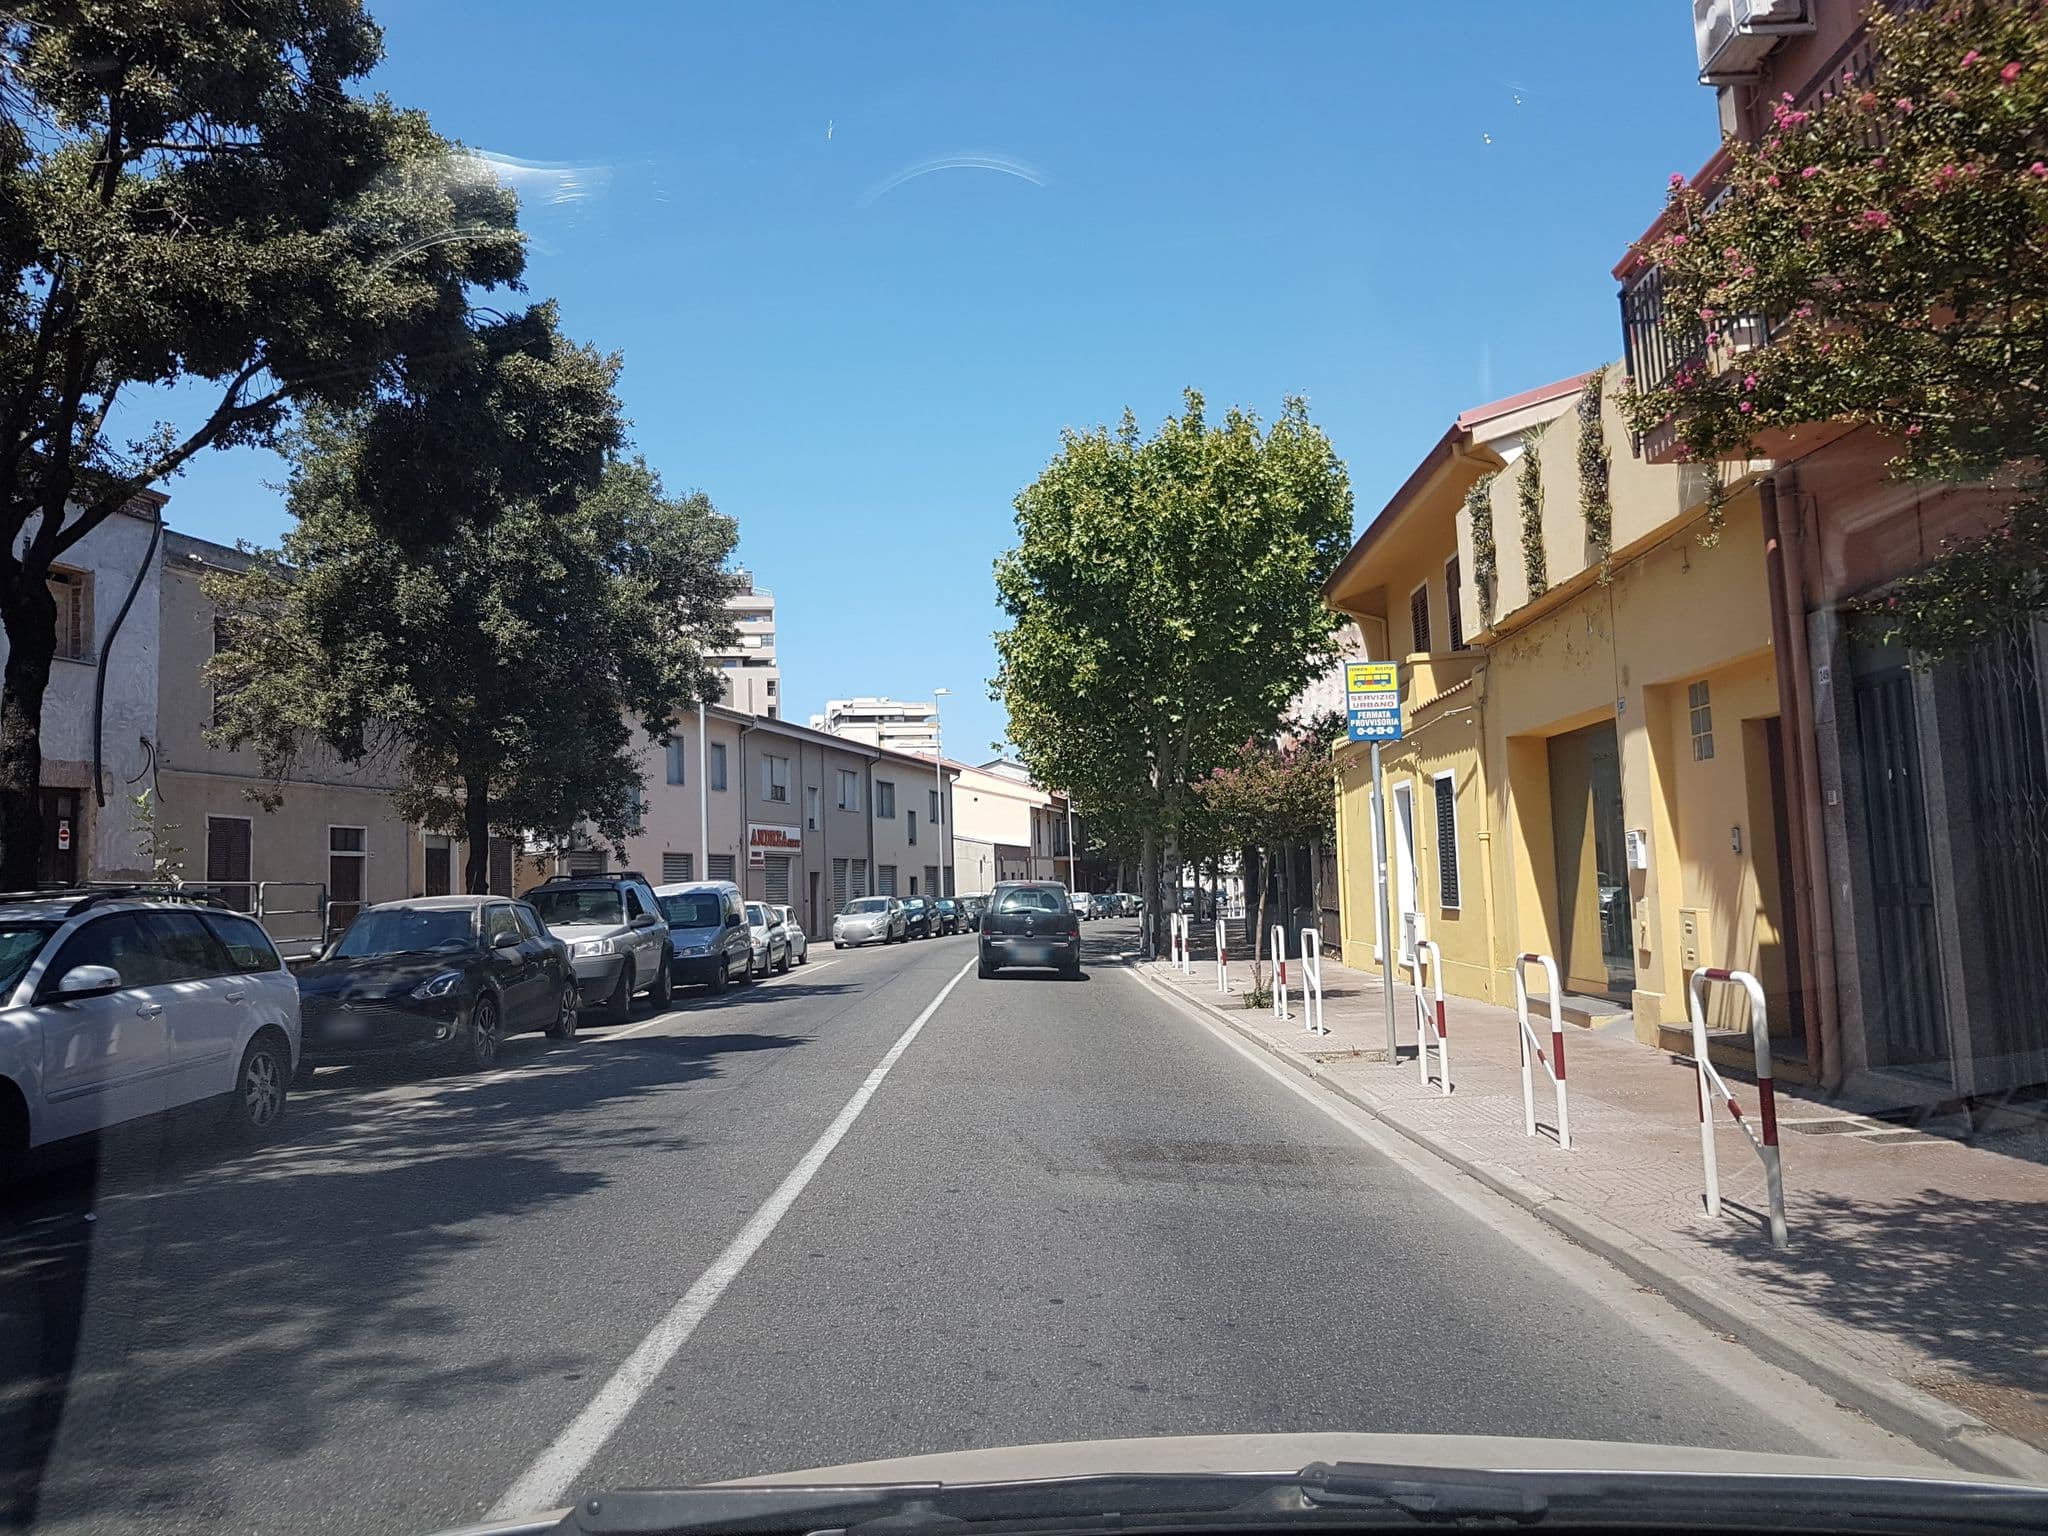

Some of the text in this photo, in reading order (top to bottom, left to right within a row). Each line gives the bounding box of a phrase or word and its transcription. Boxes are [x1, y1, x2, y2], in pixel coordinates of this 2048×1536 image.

[1358, 711, 1391, 719] FERMATA
[1350, 718, 1399, 726] PROVVISORIA
[751, 829, 788, 848] ANDREA
